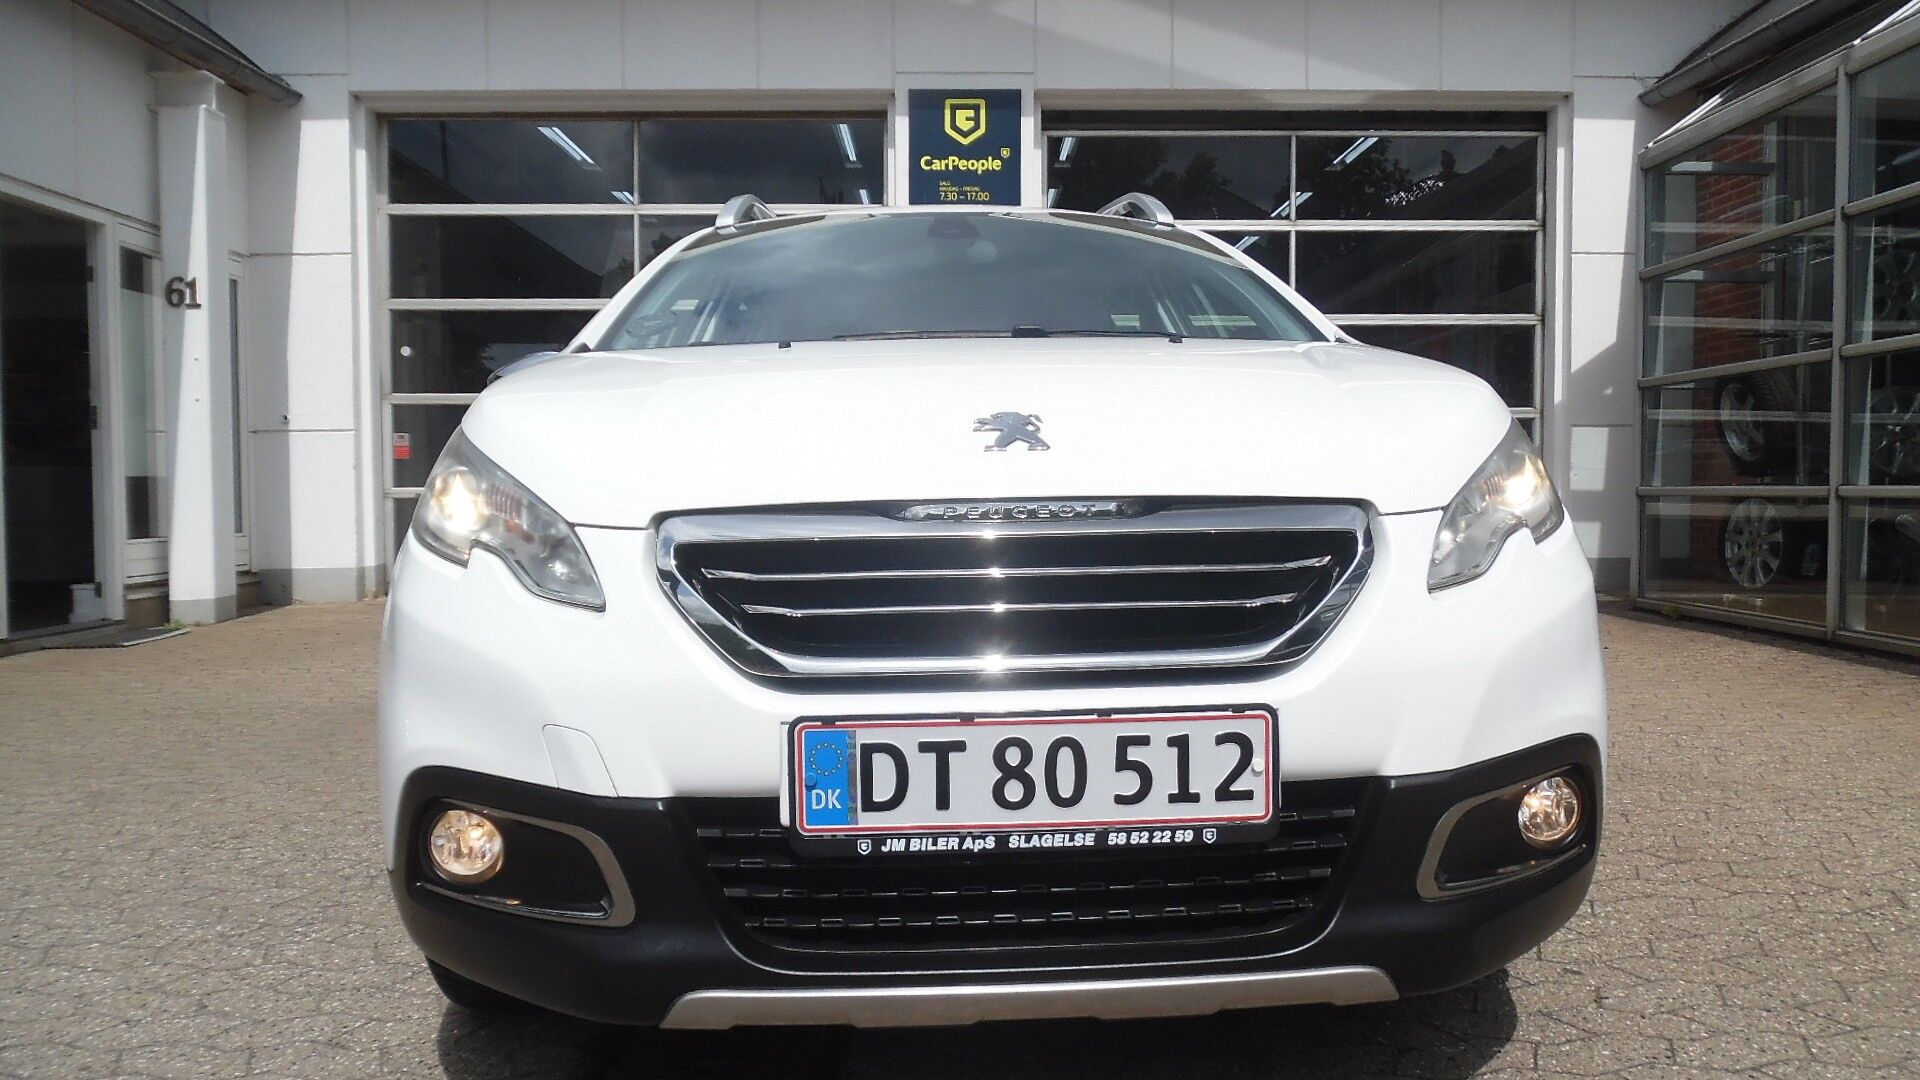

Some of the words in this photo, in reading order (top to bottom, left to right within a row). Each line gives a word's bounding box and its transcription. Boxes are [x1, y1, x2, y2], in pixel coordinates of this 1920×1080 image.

[920, 156, 1002, 175] CarPeople
[940, 192, 958, 200] 7.30
[967, 192, 990, 201] 17.00
[165, 276, 201, 310] 61
[943, 504, 1096, 519] PEUGEOT
[859, 739, 967, 813] DT
[991, 735, 1088, 811] 80
[1113, 731, 1255, 806] 512
[811, 788, 842, 810] DK
[881, 838, 905, 852] JM
[909, 837, 959, 851] BILER
[962, 835, 996, 852] ApS
[1008, 832, 1096, 849] SLAGELSE
[1107, 832, 1127, 845] 58
[1129, 831, 1149, 845] 52
[1152, 830, 1171, 844] 22
[1174, 829, 1194, 843] 59
